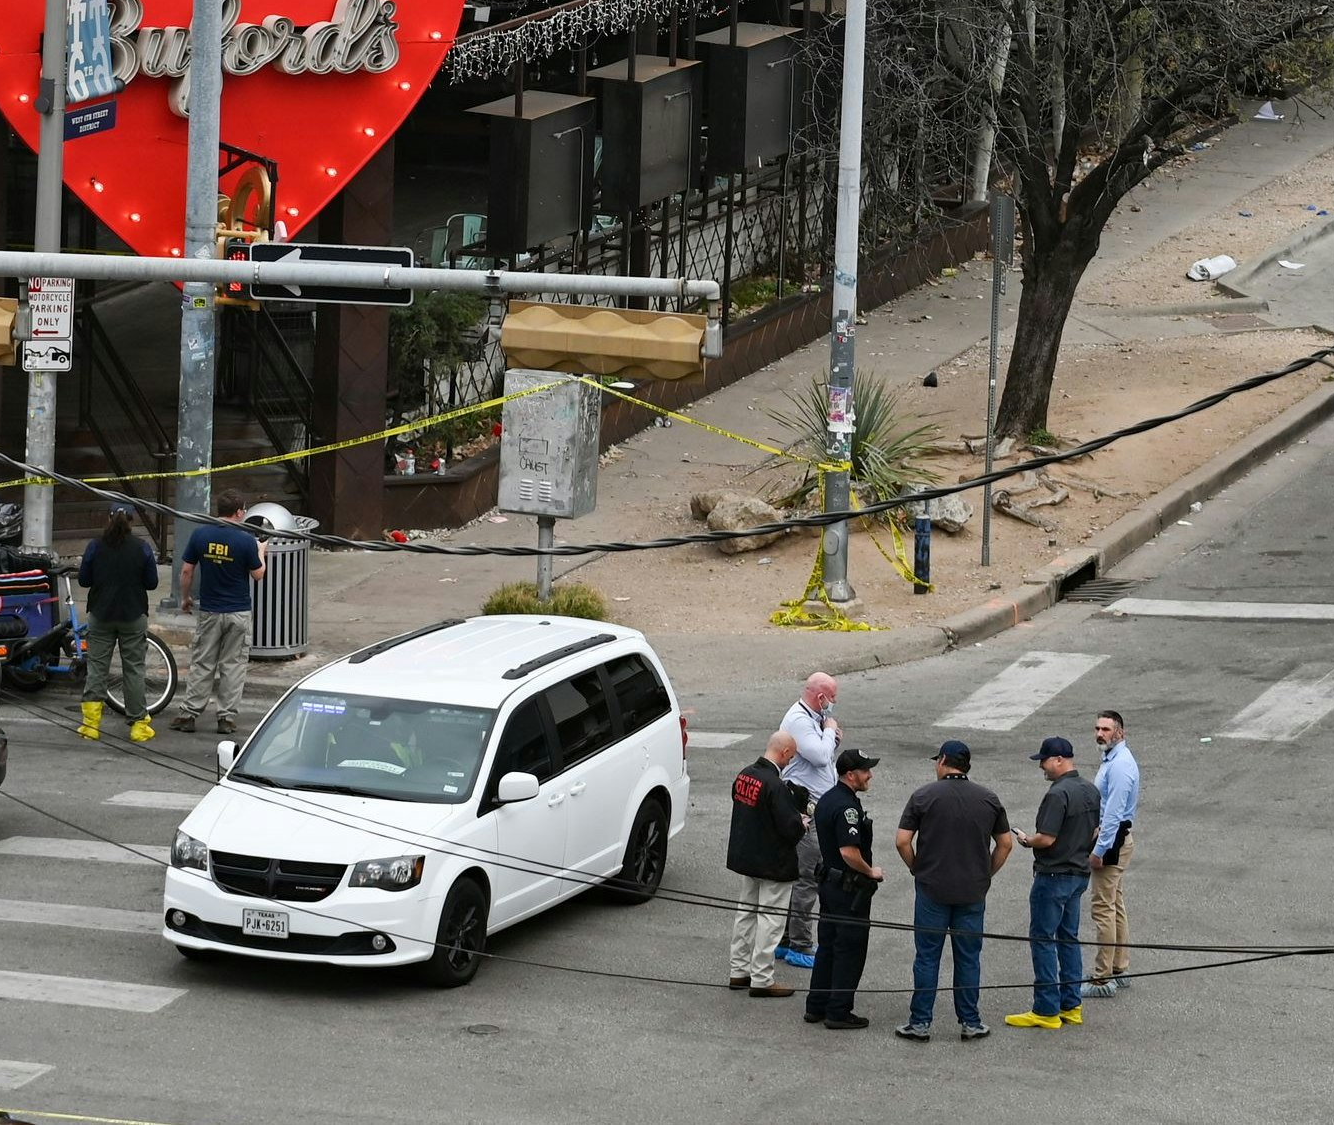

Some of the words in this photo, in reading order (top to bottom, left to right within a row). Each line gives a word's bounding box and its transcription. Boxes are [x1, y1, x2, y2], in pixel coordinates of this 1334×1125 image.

[29, 277, 40, 290] NO
[43, 278, 71, 287] PARKING
[29, 293, 70, 302] MOTORCYCLE
[31, 305, 68, 313] PARKING
[37, 318, 59, 326] ONLY
[208, 542, 229, 556] FBI
